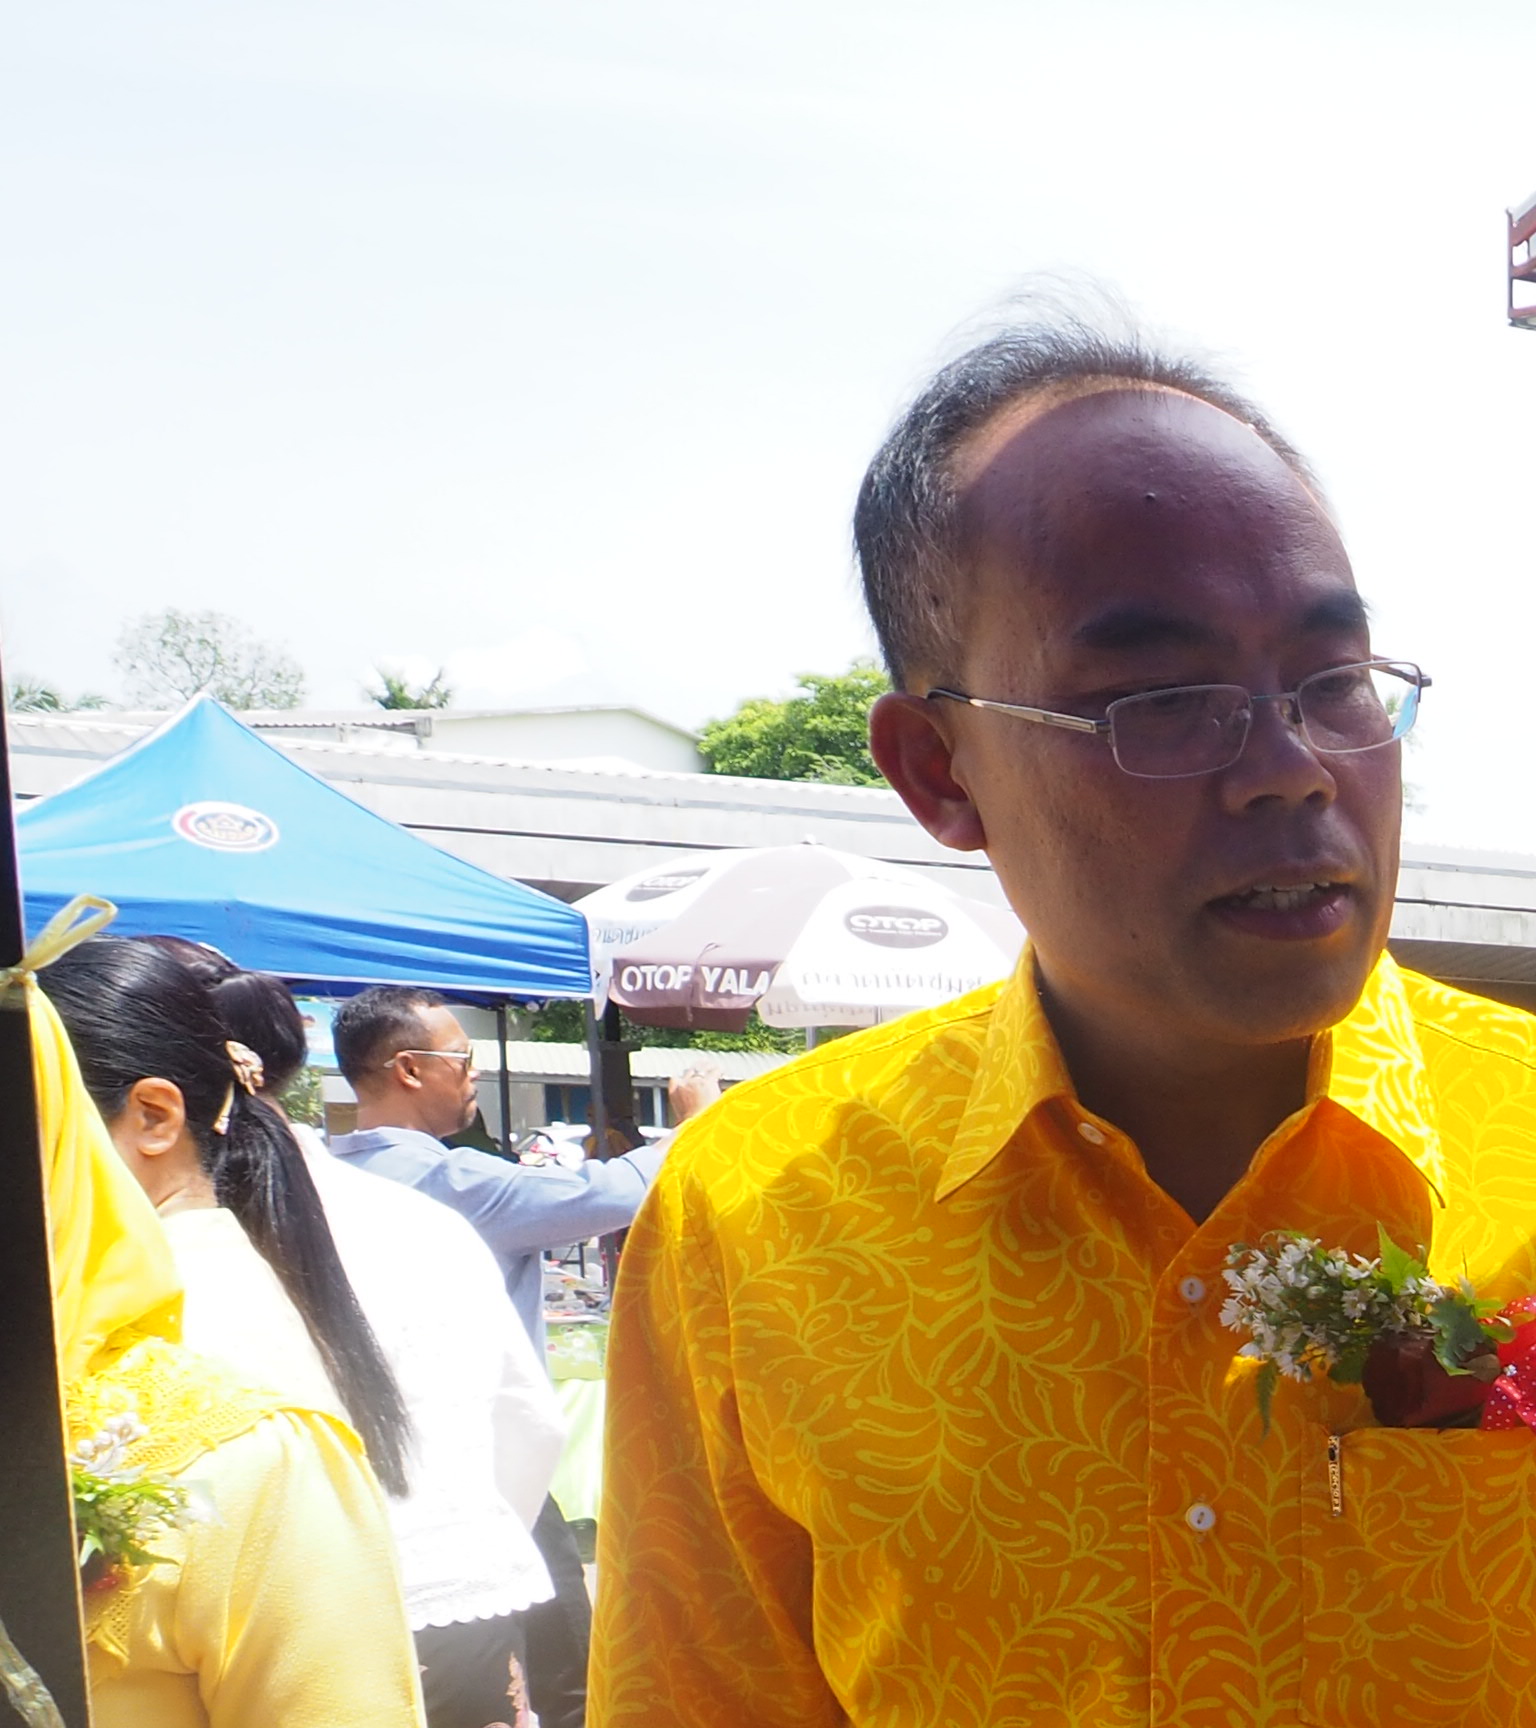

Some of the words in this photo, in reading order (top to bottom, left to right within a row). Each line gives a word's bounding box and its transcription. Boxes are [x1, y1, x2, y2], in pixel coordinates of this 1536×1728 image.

[850, 914, 942, 931] OTOP
[621, 965, 692, 992] OTOP
[701, 966, 770, 995] YALA
